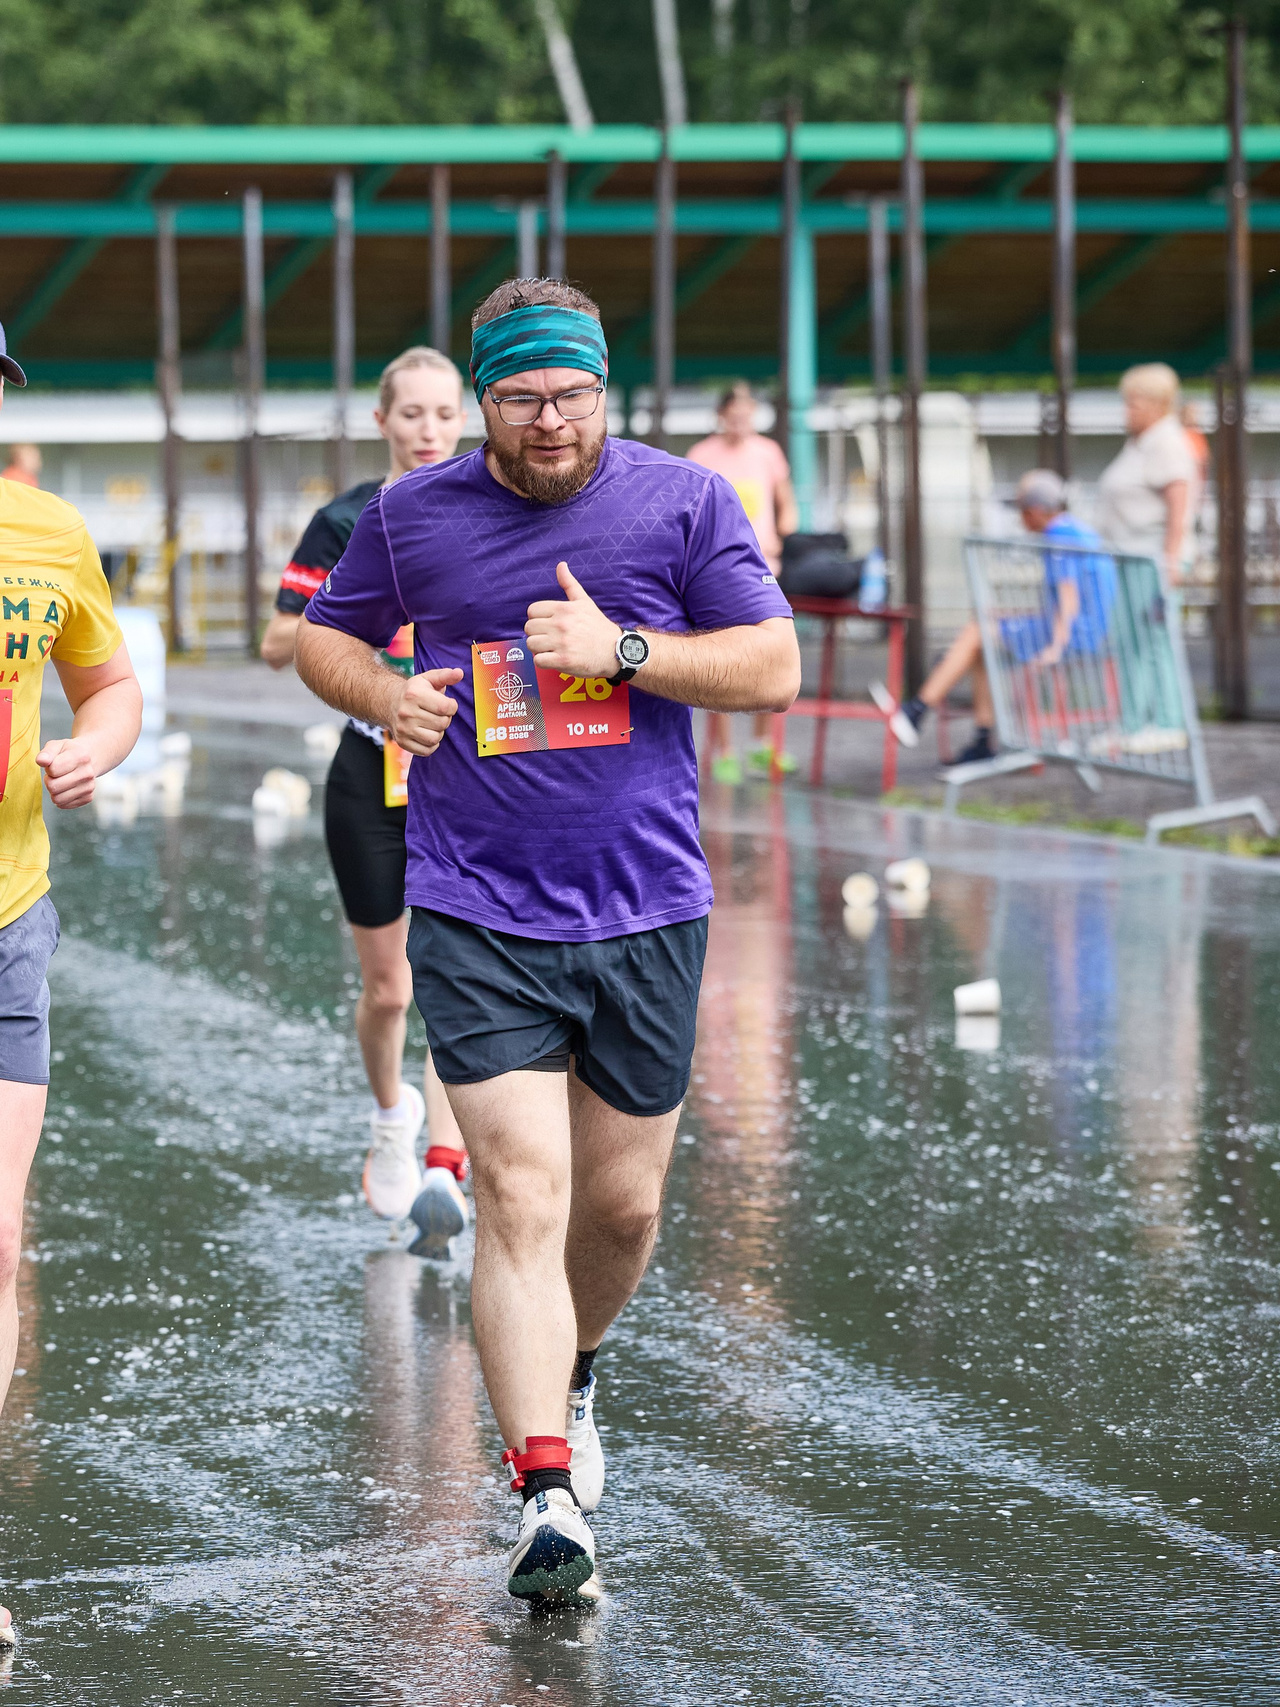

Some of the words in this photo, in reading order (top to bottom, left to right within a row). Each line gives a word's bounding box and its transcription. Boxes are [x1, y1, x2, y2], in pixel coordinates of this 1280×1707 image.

[559, 673, 613, 702] 26
[497, 701, 526, 713] АРЕНА
[485, 726, 508, 742] 28
[566, 722, 585, 736] 10
